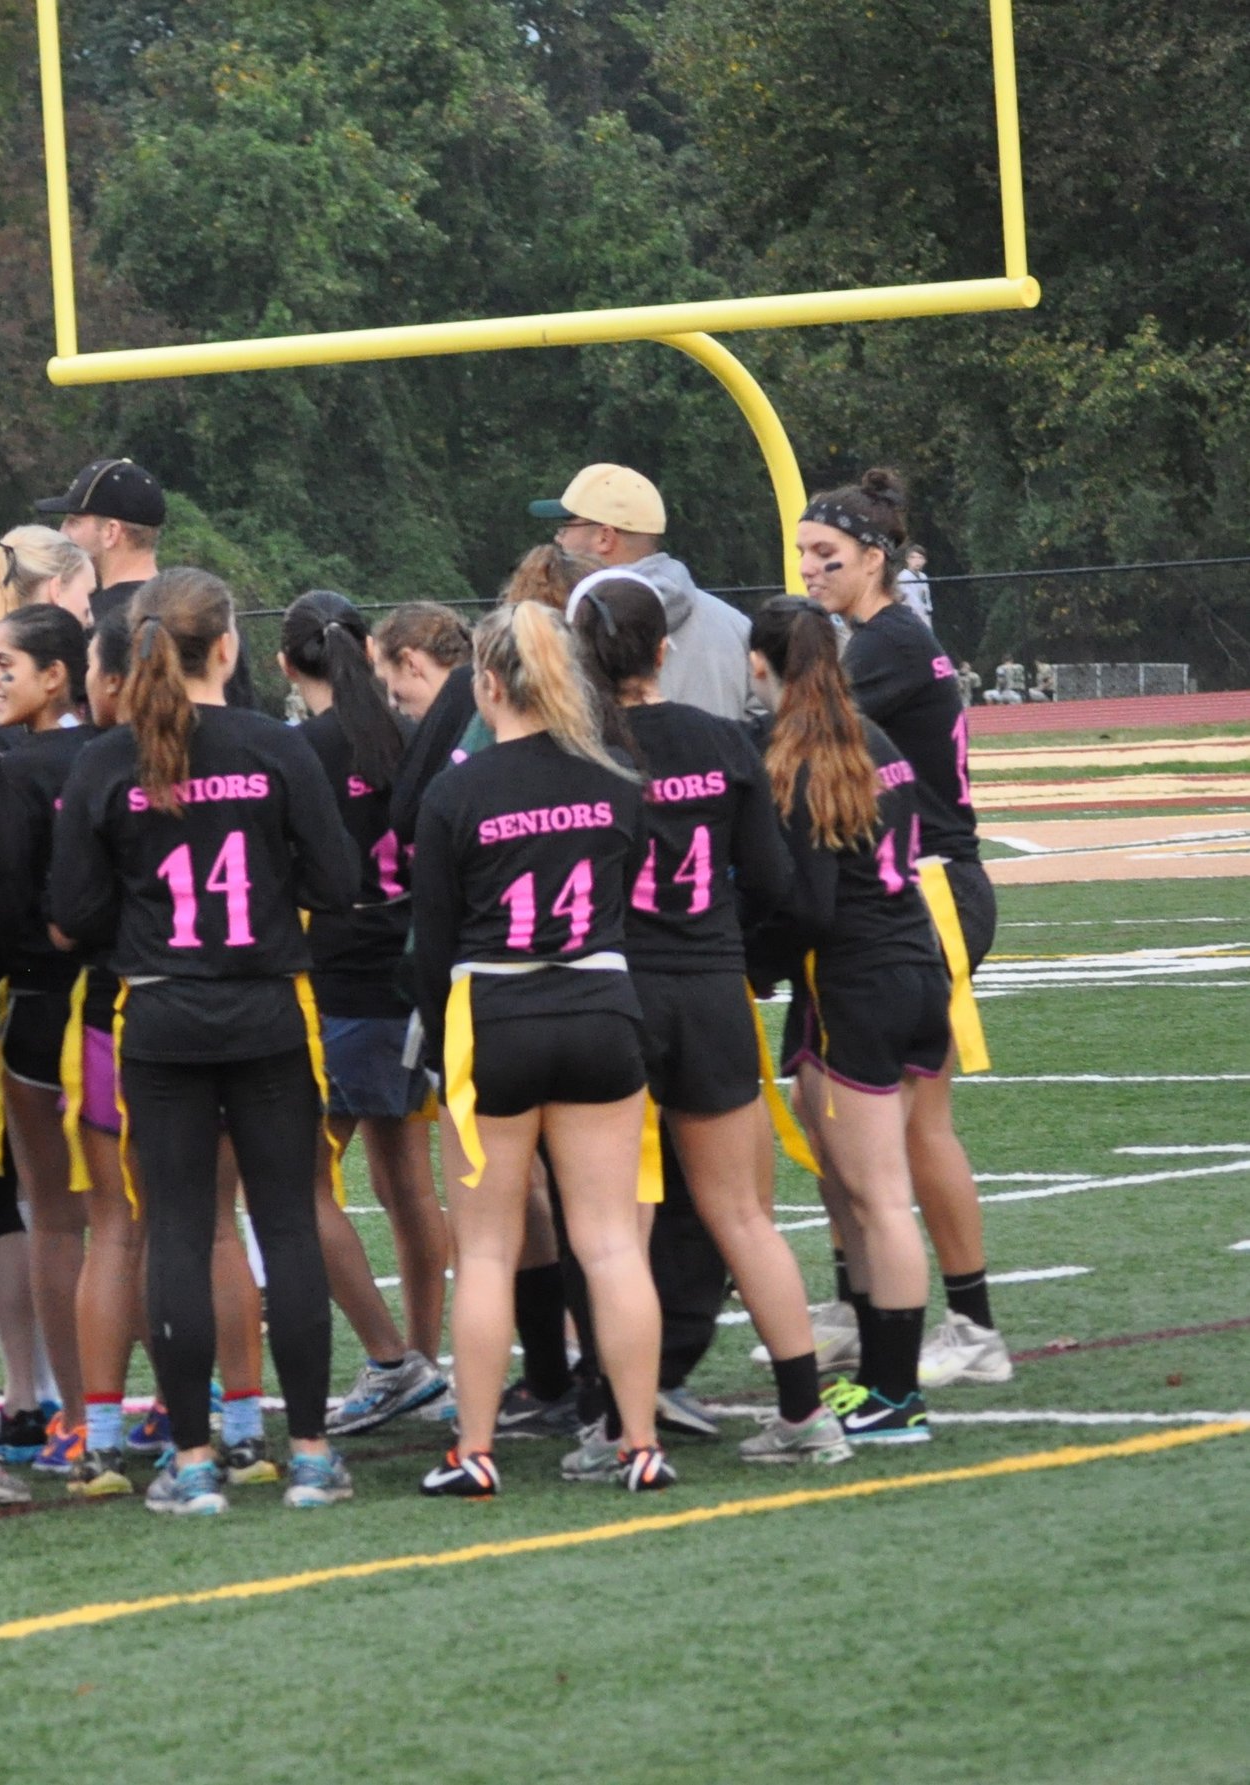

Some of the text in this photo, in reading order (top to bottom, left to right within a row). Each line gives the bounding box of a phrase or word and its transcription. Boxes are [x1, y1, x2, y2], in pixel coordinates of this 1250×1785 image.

[127, 772, 270, 812] SNIORS
[645, 770, 727, 803] IORS
[951, 712, 971, 805] 1
[479, 802, 614, 845] SENIORS
[157, 830, 257, 948] 14
[369, 828, 417, 900] 1
[501, 859, 596, 952] 14
